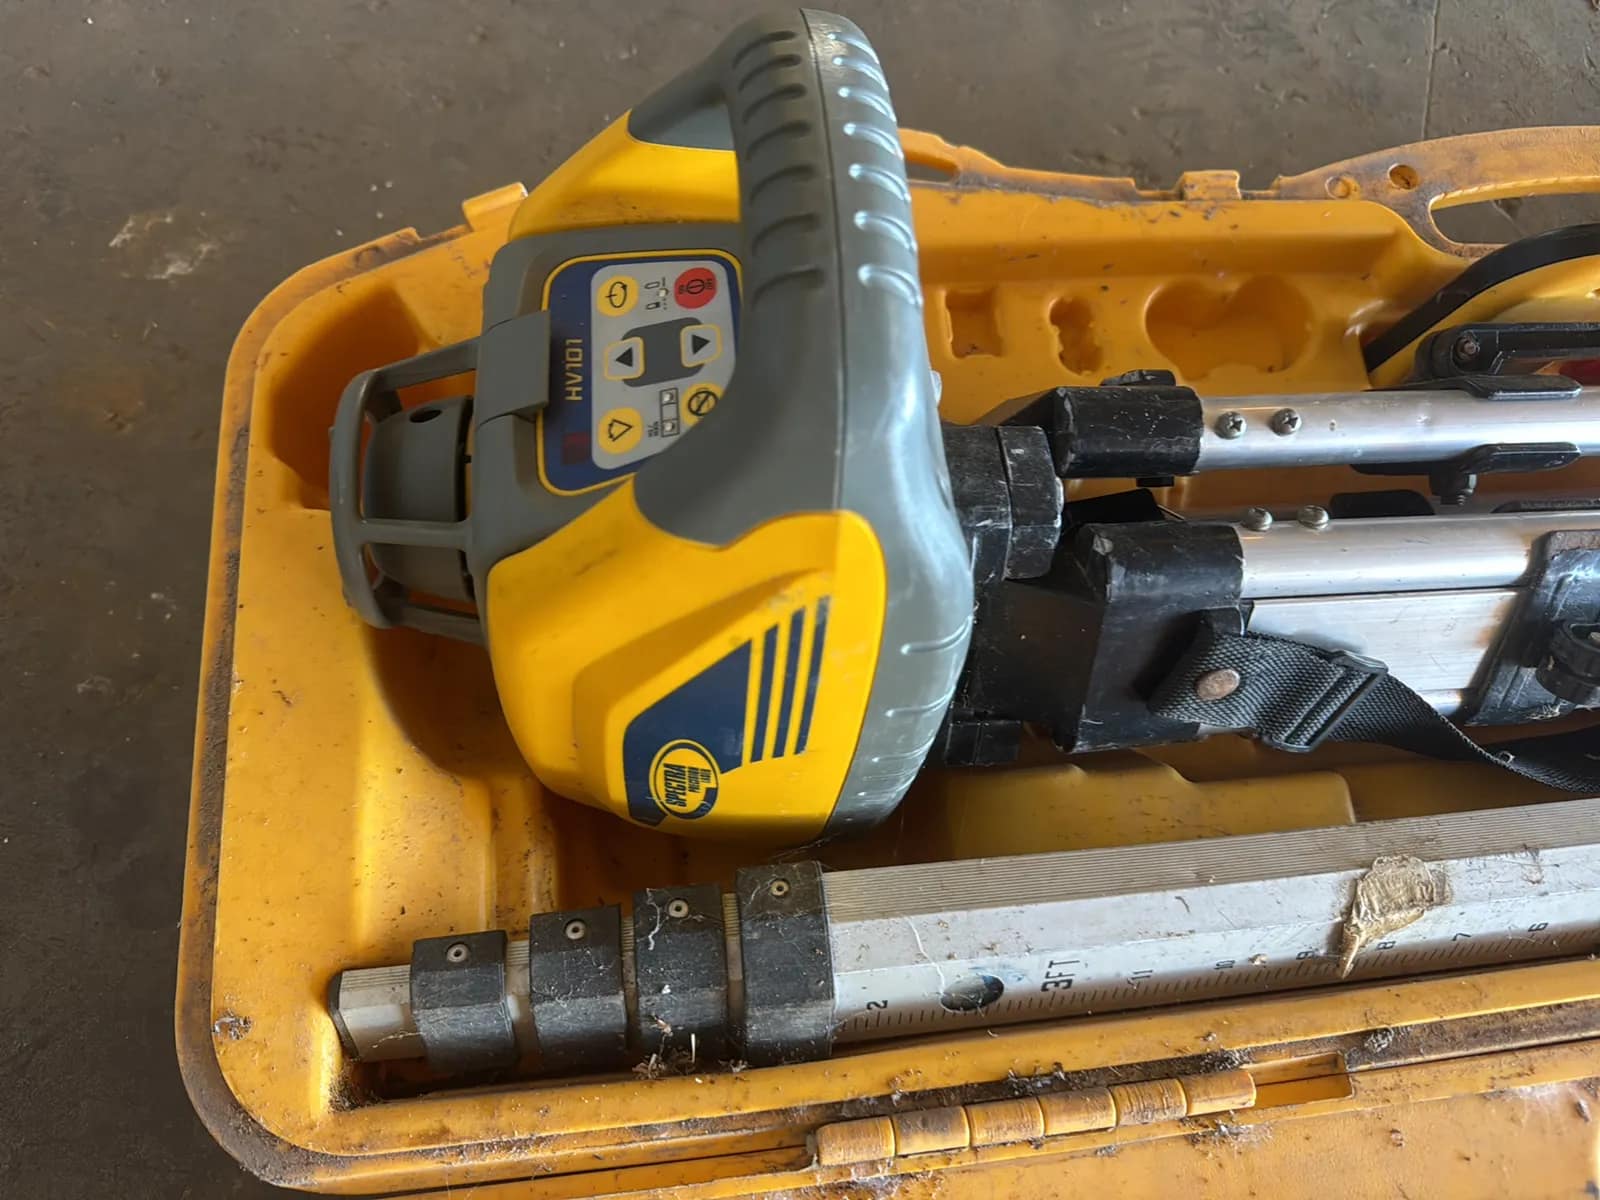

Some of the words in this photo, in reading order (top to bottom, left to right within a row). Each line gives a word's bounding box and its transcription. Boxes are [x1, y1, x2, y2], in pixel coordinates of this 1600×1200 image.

[565, 338, 583, 401] HV101
[663, 763, 687, 807] SPECTRA
[1528, 922, 1549, 932] 6
[1451, 932, 1472, 942] 7
[1375, 940, 1397, 950] 8
[1040, 959, 1081, 992] 3FT
[866, 999, 889, 1010] 2
